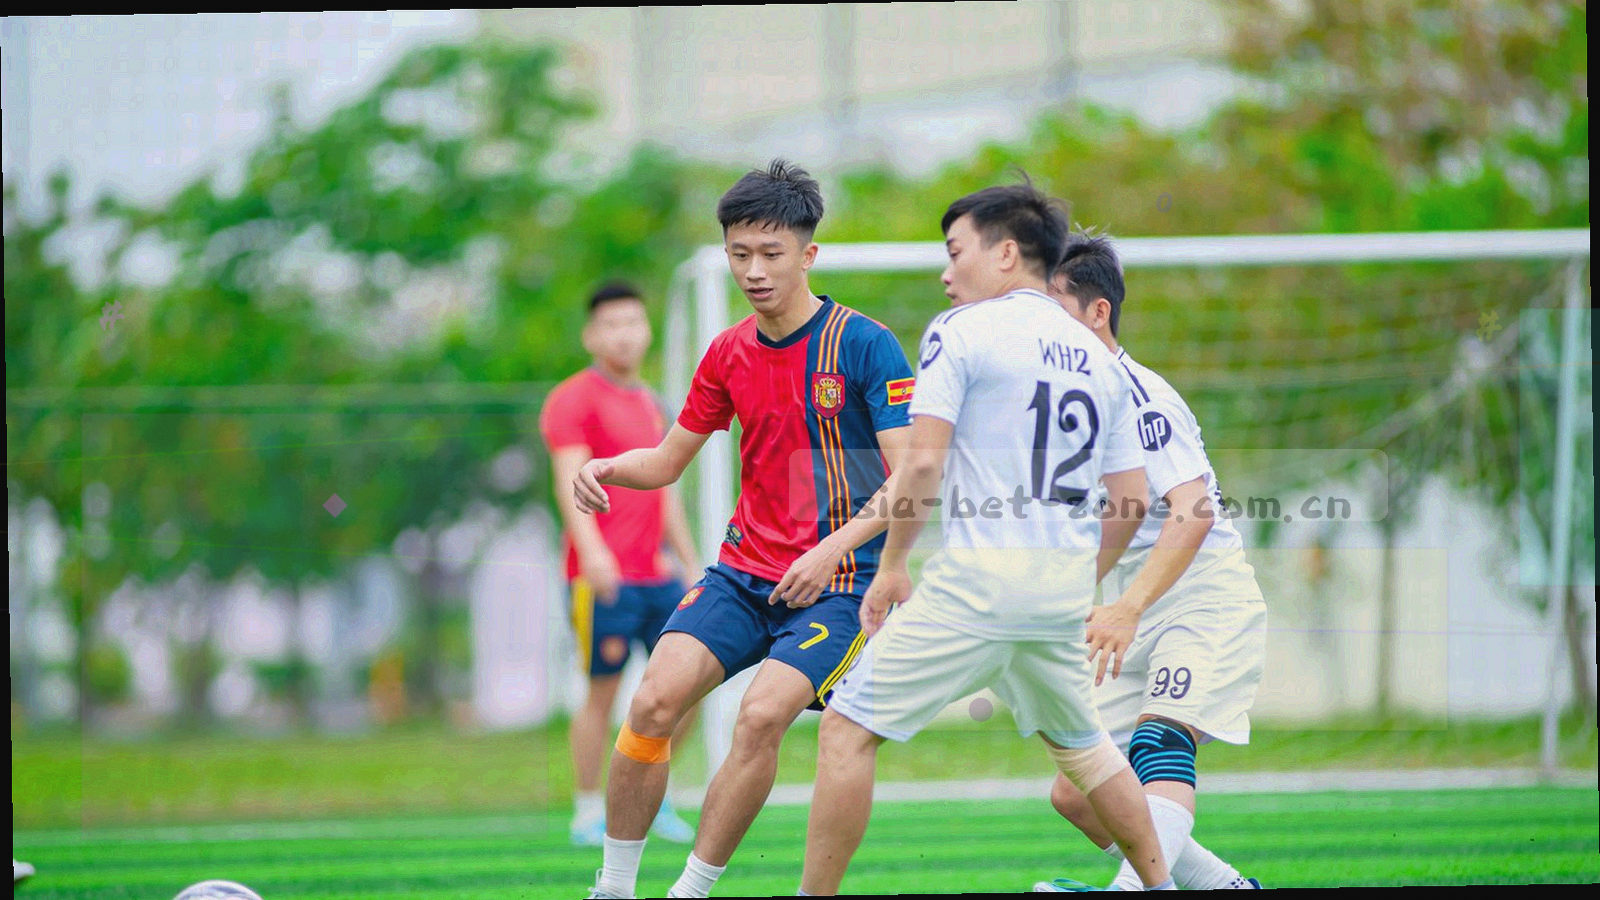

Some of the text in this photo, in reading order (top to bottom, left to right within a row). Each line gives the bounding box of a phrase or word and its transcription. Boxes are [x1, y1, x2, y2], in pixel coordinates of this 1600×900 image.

[1038, 337, 1091, 376] WH2
[1026, 379, 1100, 506] 12
[1138, 411, 1170, 451] hp
[798, 622, 829, 649] 7
[1150, 667, 1192, 700] 99
